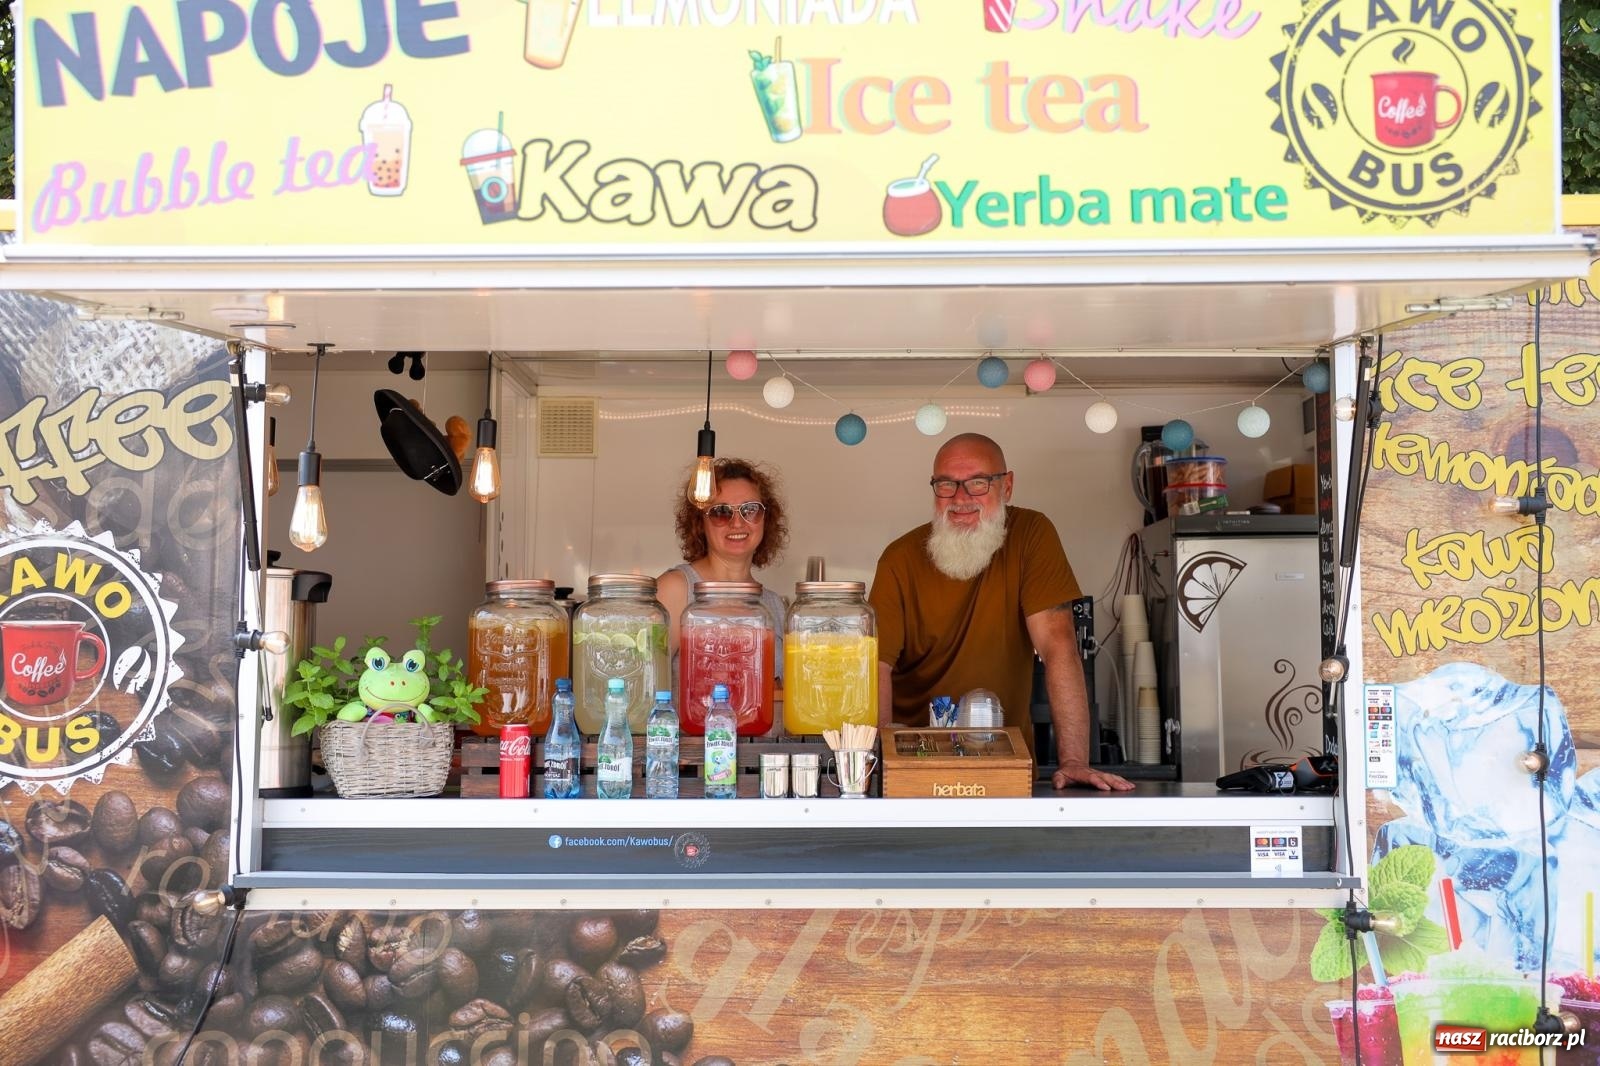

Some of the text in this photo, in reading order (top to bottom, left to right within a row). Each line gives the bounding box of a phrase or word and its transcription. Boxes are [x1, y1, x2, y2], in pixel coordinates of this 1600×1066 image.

[31, 0, 471, 107] NAPOJE
[1317, 0, 1487, 57] KAWO
[797, 57, 1149, 134] Ice tea
[1378, 95, 1426, 124] Coffee
[31, 135, 379, 233] Bubble tea
[516, 138, 819, 231] Kawa
[938, 174, 1289, 229] Yerba mate
[1348, 150, 1463, 196] BUS
[1505, 342, 1600, 408] te
[0, 552, 132, 619] AWO
[1401, 524, 1554, 590] kawa
[11, 648, 67, 682] Coffee
[0, 712, 100, 763] BUS
[933, 782, 986, 797] herbata
[565, 836, 674, 848] facebook.com/Kawobus/
